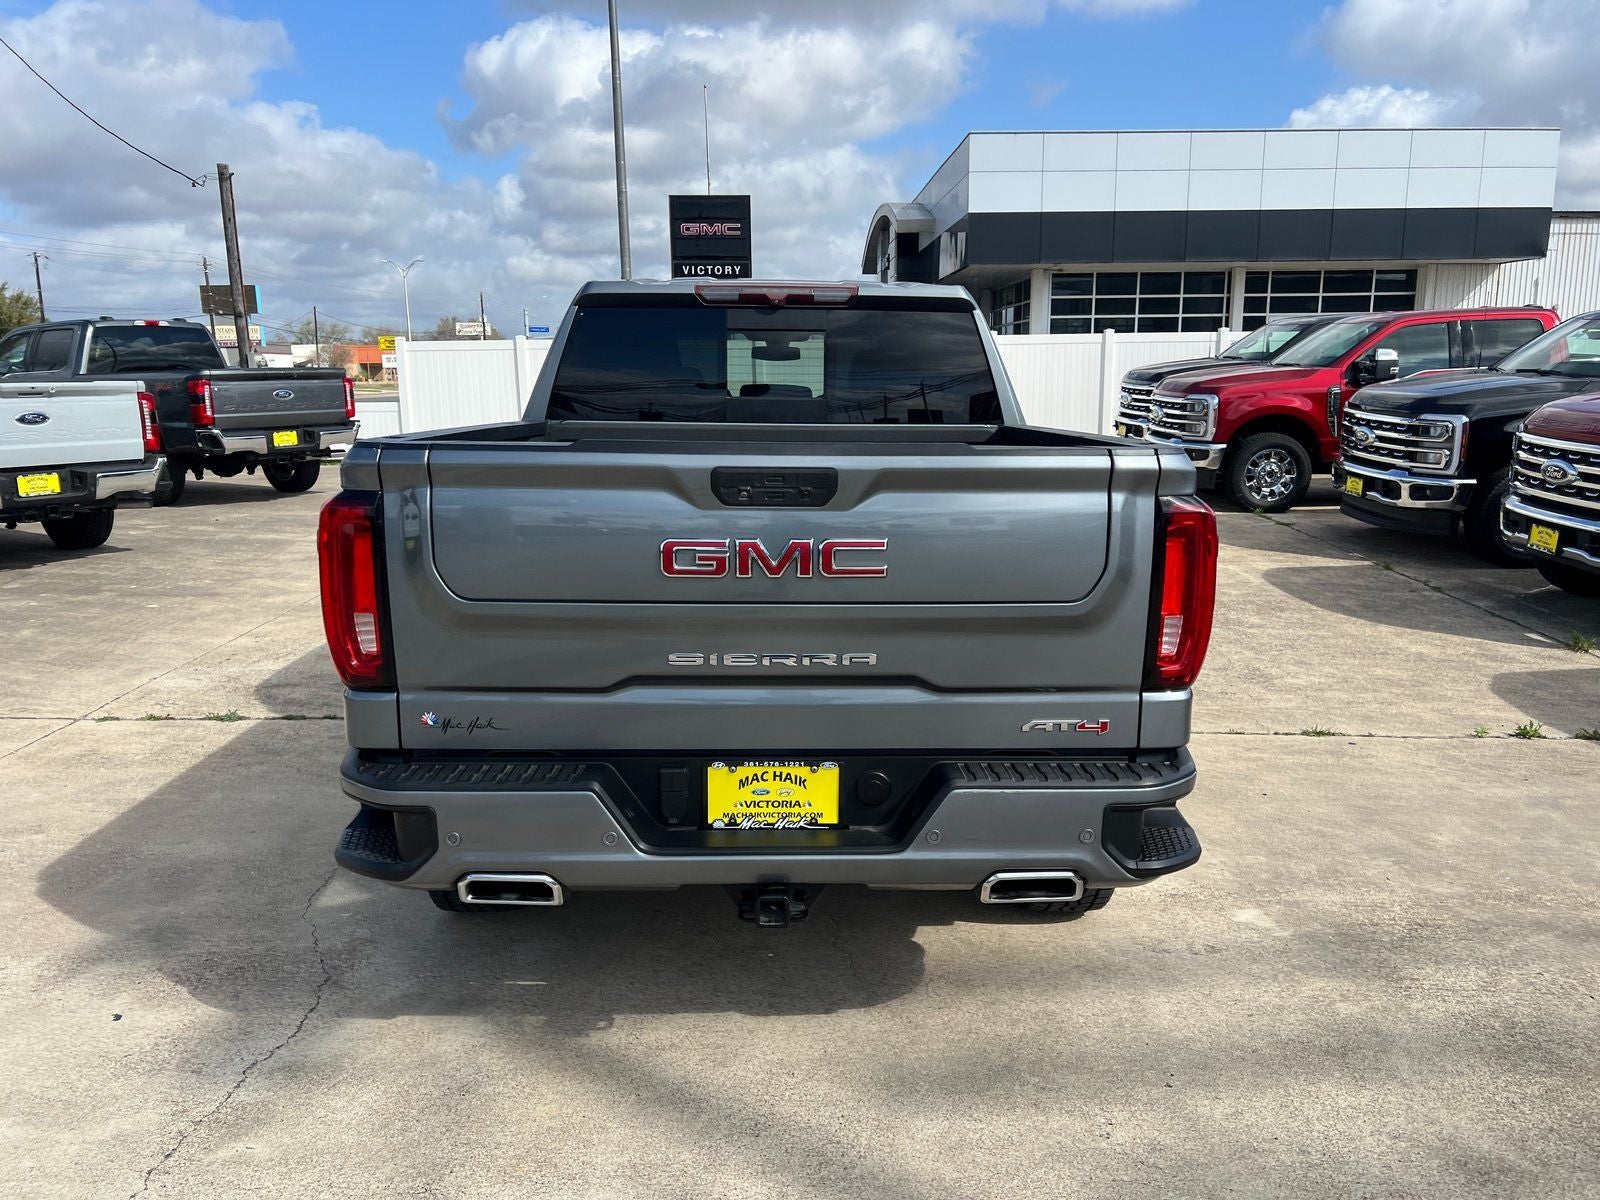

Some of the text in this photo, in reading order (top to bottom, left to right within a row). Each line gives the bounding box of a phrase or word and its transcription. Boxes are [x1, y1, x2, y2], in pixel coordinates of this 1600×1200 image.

[681, 223, 740, 235] GMC
[682, 265, 741, 275] VICTORY
[1545, 466, 1563, 479] Ford
[661, 538, 888, 577] GMC
[668, 653, 877, 666] SIERRA
[440, 717, 511, 735] Mac Haik
[1022, 720, 1109, 734] AT4
[738, 771, 808, 790] MAC HAIK
[744, 800, 802, 808] VICTORIA
[722, 811, 824, 819] MACHAIKVICTORIA.COM
[739, 815, 829, 830] Mac Haik
